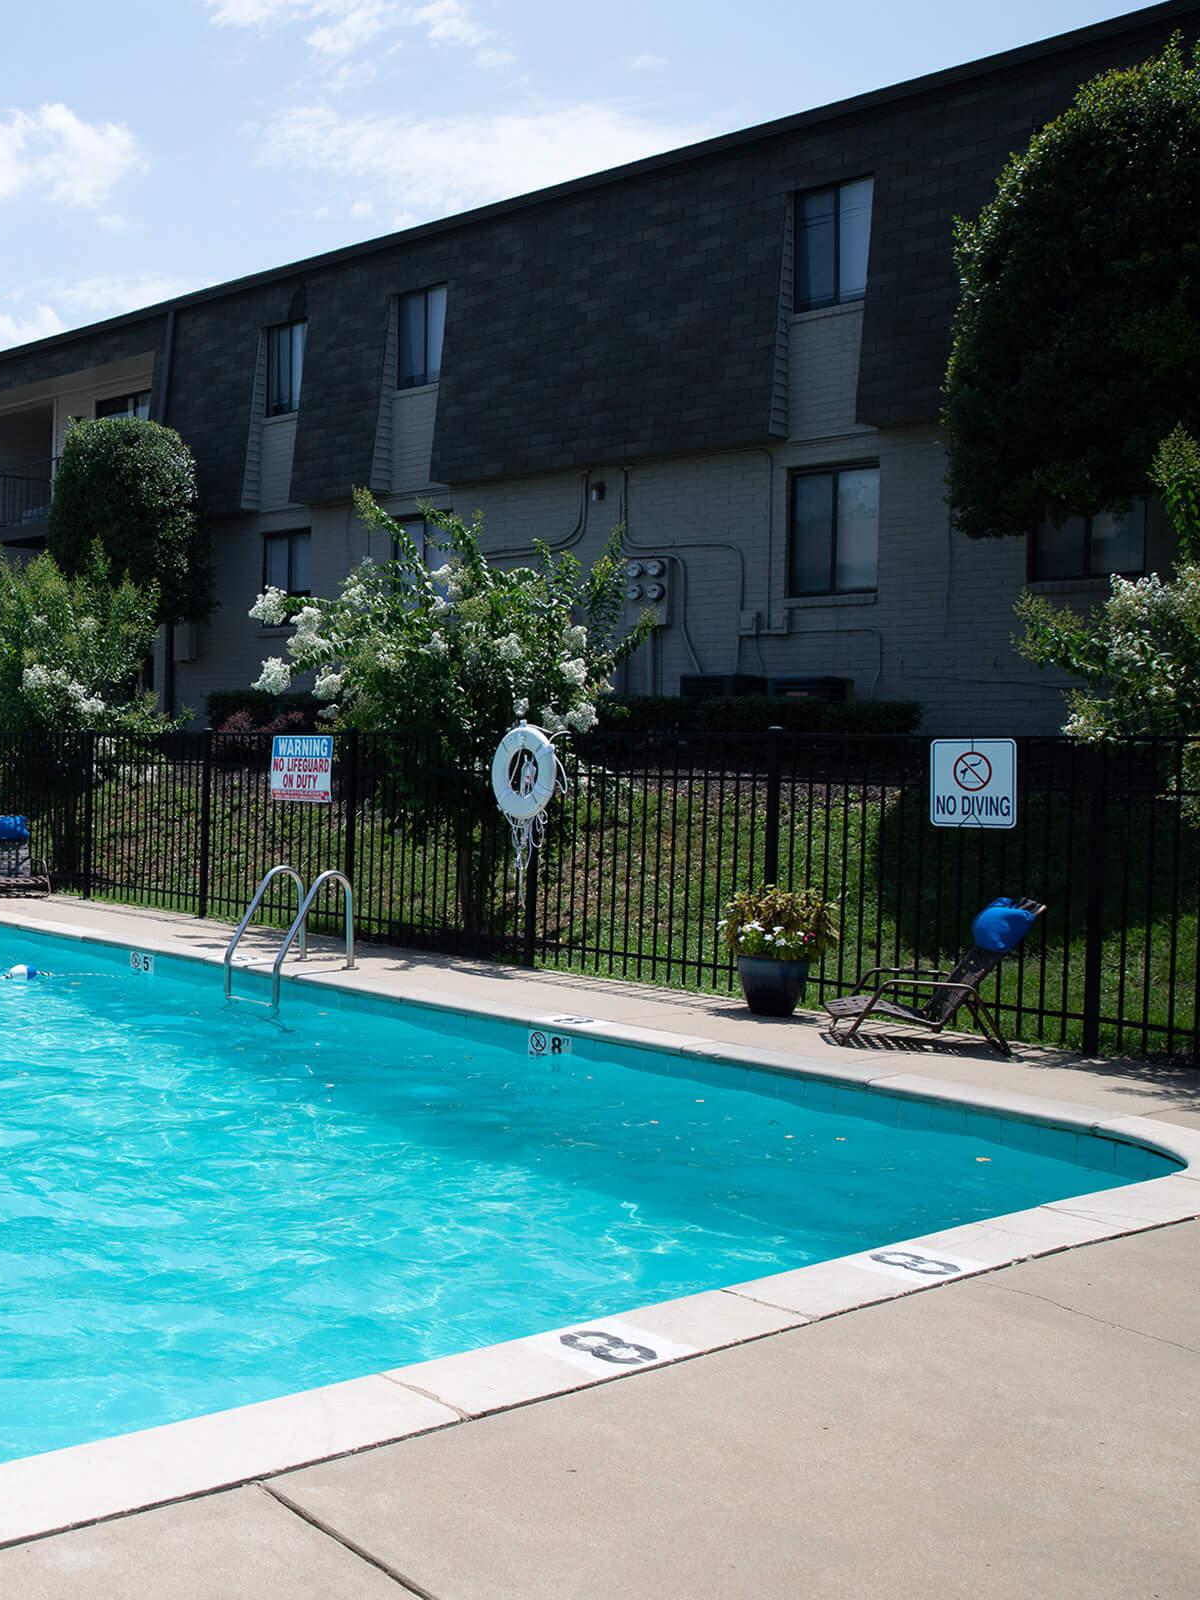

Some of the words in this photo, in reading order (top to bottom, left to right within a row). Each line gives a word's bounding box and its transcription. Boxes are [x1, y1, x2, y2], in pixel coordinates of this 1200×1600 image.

[278, 738, 328, 756] WARNING
[273, 758, 284, 772] NO
[287, 758, 329, 773] LIFEGUARD
[283, 774, 293, 788] ON
[296, 774, 318, 789] DUTY
[936, 795, 956, 815] NO
[961, 796, 1011, 816] DIVING
[143, 956, 149, 971] 5
[551, 1036, 562, 1054] 8
[559, 1330, 658, 1365] 8
